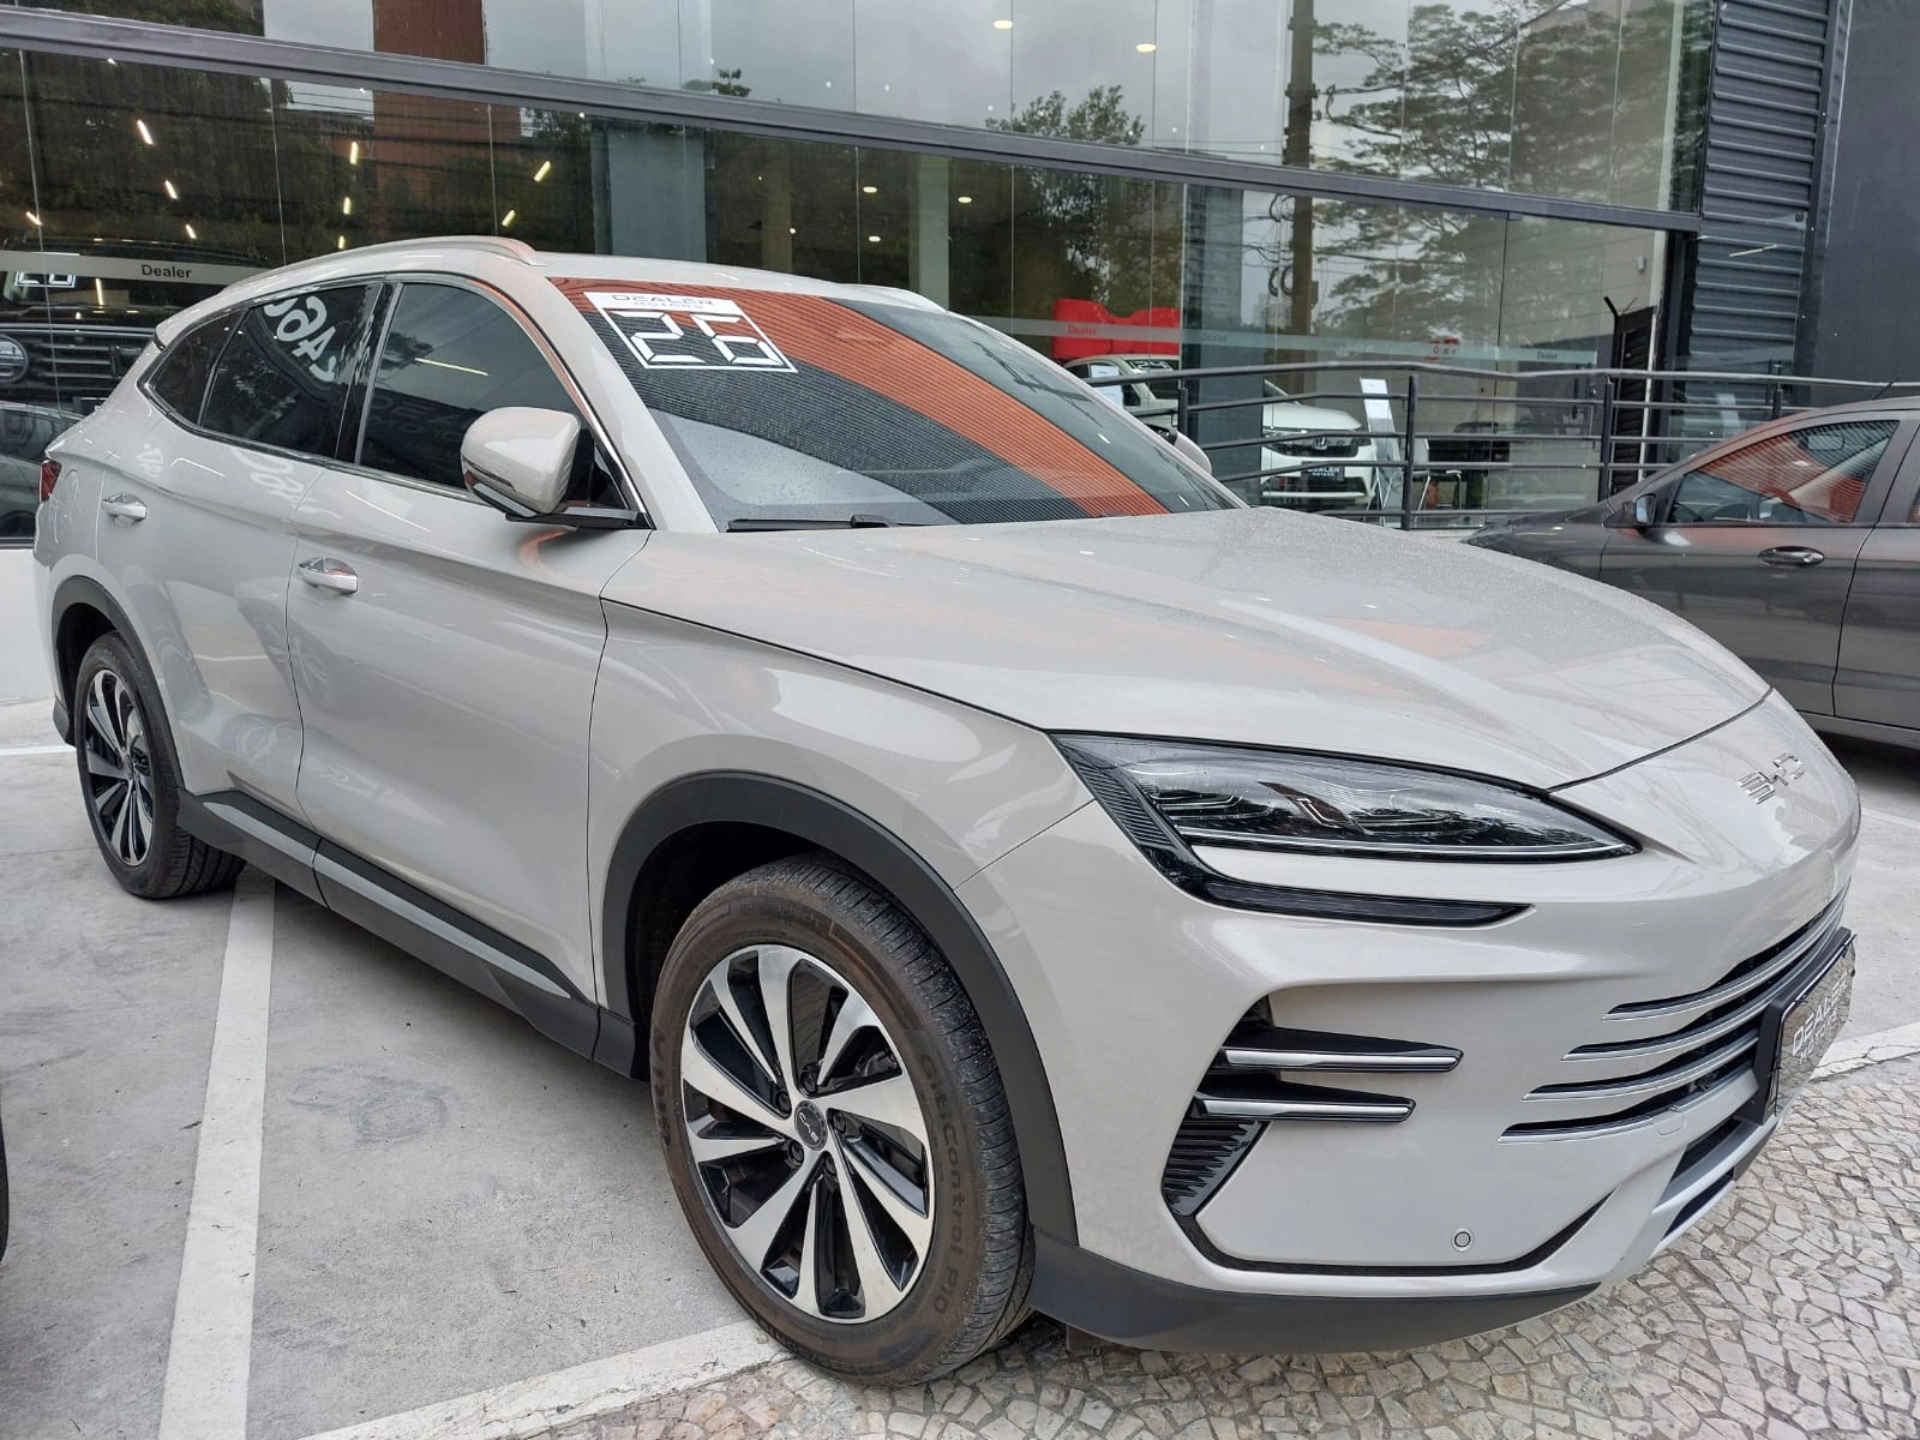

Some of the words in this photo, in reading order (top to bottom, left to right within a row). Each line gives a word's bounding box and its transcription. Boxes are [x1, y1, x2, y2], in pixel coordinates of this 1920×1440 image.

[142, 264, 192, 278] Dealer
[612, 294, 713, 305] DEALER
[611, 310, 785, 366] 26
[1736, 752, 1807, 805] BYD
[1792, 970, 1848, 1057] DEALER
